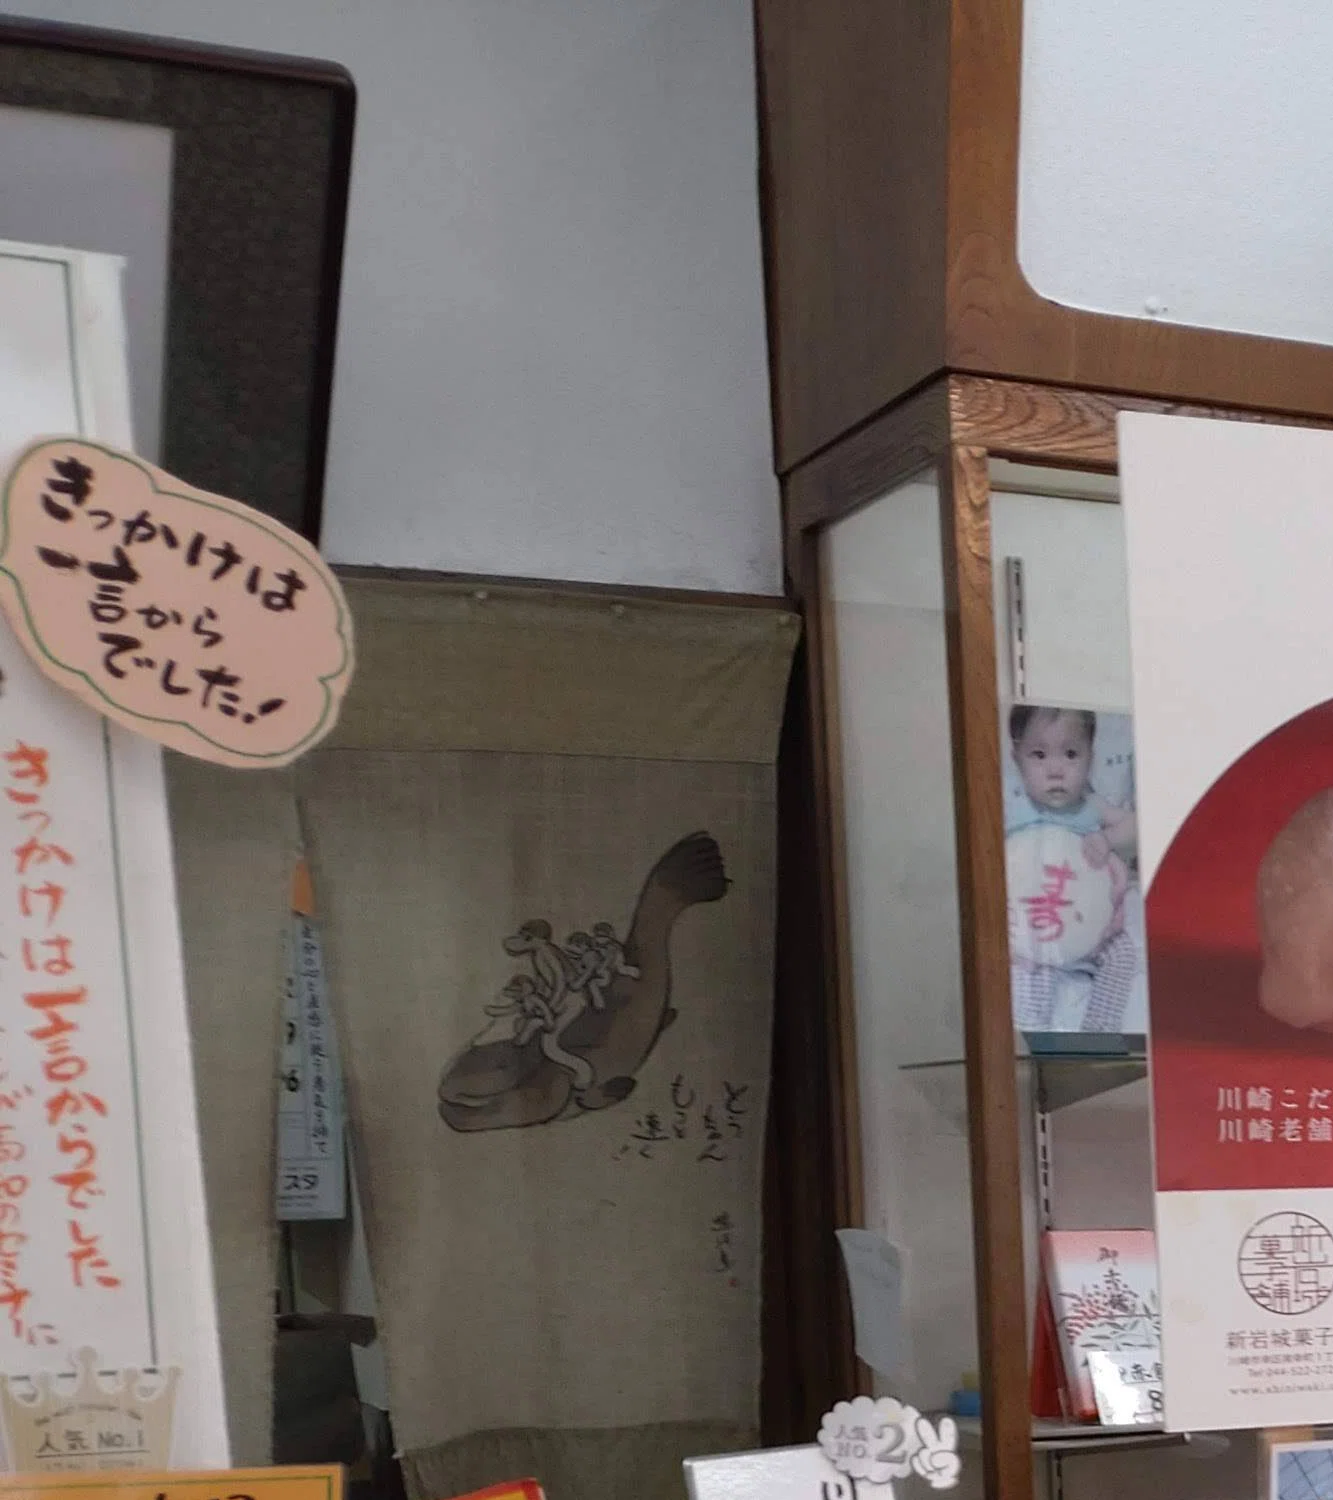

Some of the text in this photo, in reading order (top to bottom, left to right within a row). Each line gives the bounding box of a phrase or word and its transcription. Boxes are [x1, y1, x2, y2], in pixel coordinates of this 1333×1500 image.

[39, 455, 308, 613] きっかけは
[38, 545, 224, 649] 一言から
[39, 1430, 89, 1452] 人気
